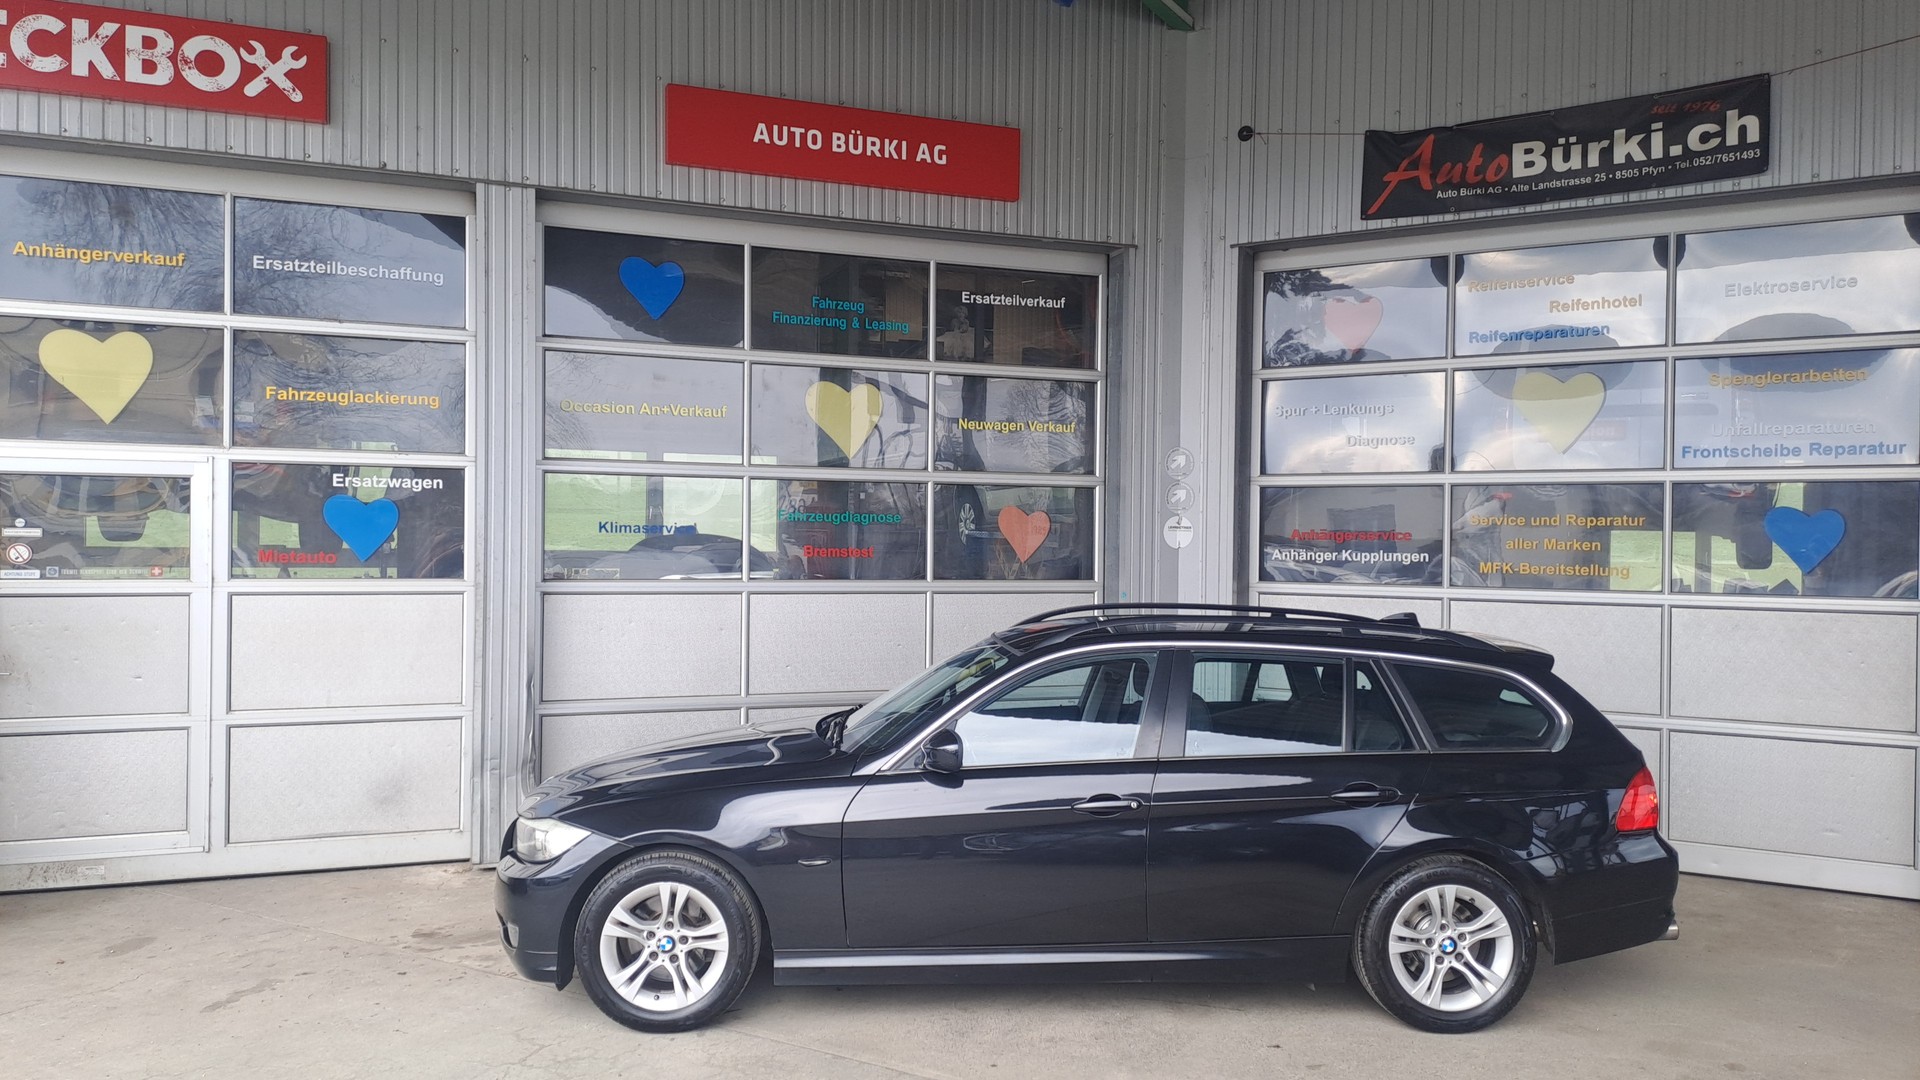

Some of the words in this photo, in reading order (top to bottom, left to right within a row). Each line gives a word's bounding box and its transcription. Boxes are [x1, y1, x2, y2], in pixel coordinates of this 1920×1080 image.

[1682, 100, 1721, 113] 1976
[752, 121, 823, 151] AUTO
[831, 130, 907, 161] BÜRKI
[915, 142, 948, 165] AG
[1436, 188, 1458, 199] Auto
[1460, 185, 1486, 197] Bürki
[1487, 185, 1503, 195] AG
[1510, 181, 1530, 193] Alte
[1532, 173, 1592, 191] Landstrasse
[1594, 172, 1607, 183] 25
[1615, 168, 1639, 180] 8505
[1642, 164, 1666, 180] Pfyn
[13, 241, 185, 268] Anhängerverkauf
[253, 254, 445, 287] Ersatzteilbeschaffung
[1467, 272, 1575, 294] Reifenservice
[1725, 275, 1858, 298] Elektroservice
[811, 296, 865, 314] Fahrzeug
[961, 291, 1066, 309] Ersatzteilverkauf
[1549, 294, 1643, 313] Reifenhotel
[772, 311, 847, 330] Finanzierung
[852, 317, 861, 329] &
[865, 317, 910, 334] Leasing
[1469, 322, 1610, 343] Reifenreparaturen
[1708, 367, 1869, 390] Spenglerarbeiten
[265, 386, 441, 409] Fahrzeuglackierung
[560, 398, 635, 417] Occasion
[638, 401, 727, 419] An+Verkauf
[1275, 404, 1307, 419] Spur
[1322, 402, 1394, 418] Lenkungs
[958, 418, 1026, 435] Neuwagen
[1029, 420, 1076, 435] Verkauf
[1711, 421, 1876, 438] Unfallreparaturen
[1346, 433, 1416, 449] Diagnose
[1681, 444, 1801, 459] Frontscheibe
[1809, 441, 1907, 459] Reparatur
[332, 473, 443, 491] Ersatzwagen
[778, 509, 901, 526] Fahrzeugdiagnose
[1470, 513, 1526, 526] Service
[1531, 513, 1560, 526] und
[1565, 513, 1646, 529] Reparatur
[598, 521, 697, 534] Klimaservi
[1290, 527, 1412, 544] Anhängerservice
[803, 544, 875, 559] Bremstest
[1505, 538, 1537, 550] aller
[1541, 538, 1601, 551] Marken
[258, 549, 337, 565] Mietauto
[1272, 549, 1338, 565] Anhänger
[1342, 549, 1430, 565] Kupplungen
[1479, 562, 1630, 580] MFK-Bereitstellung
